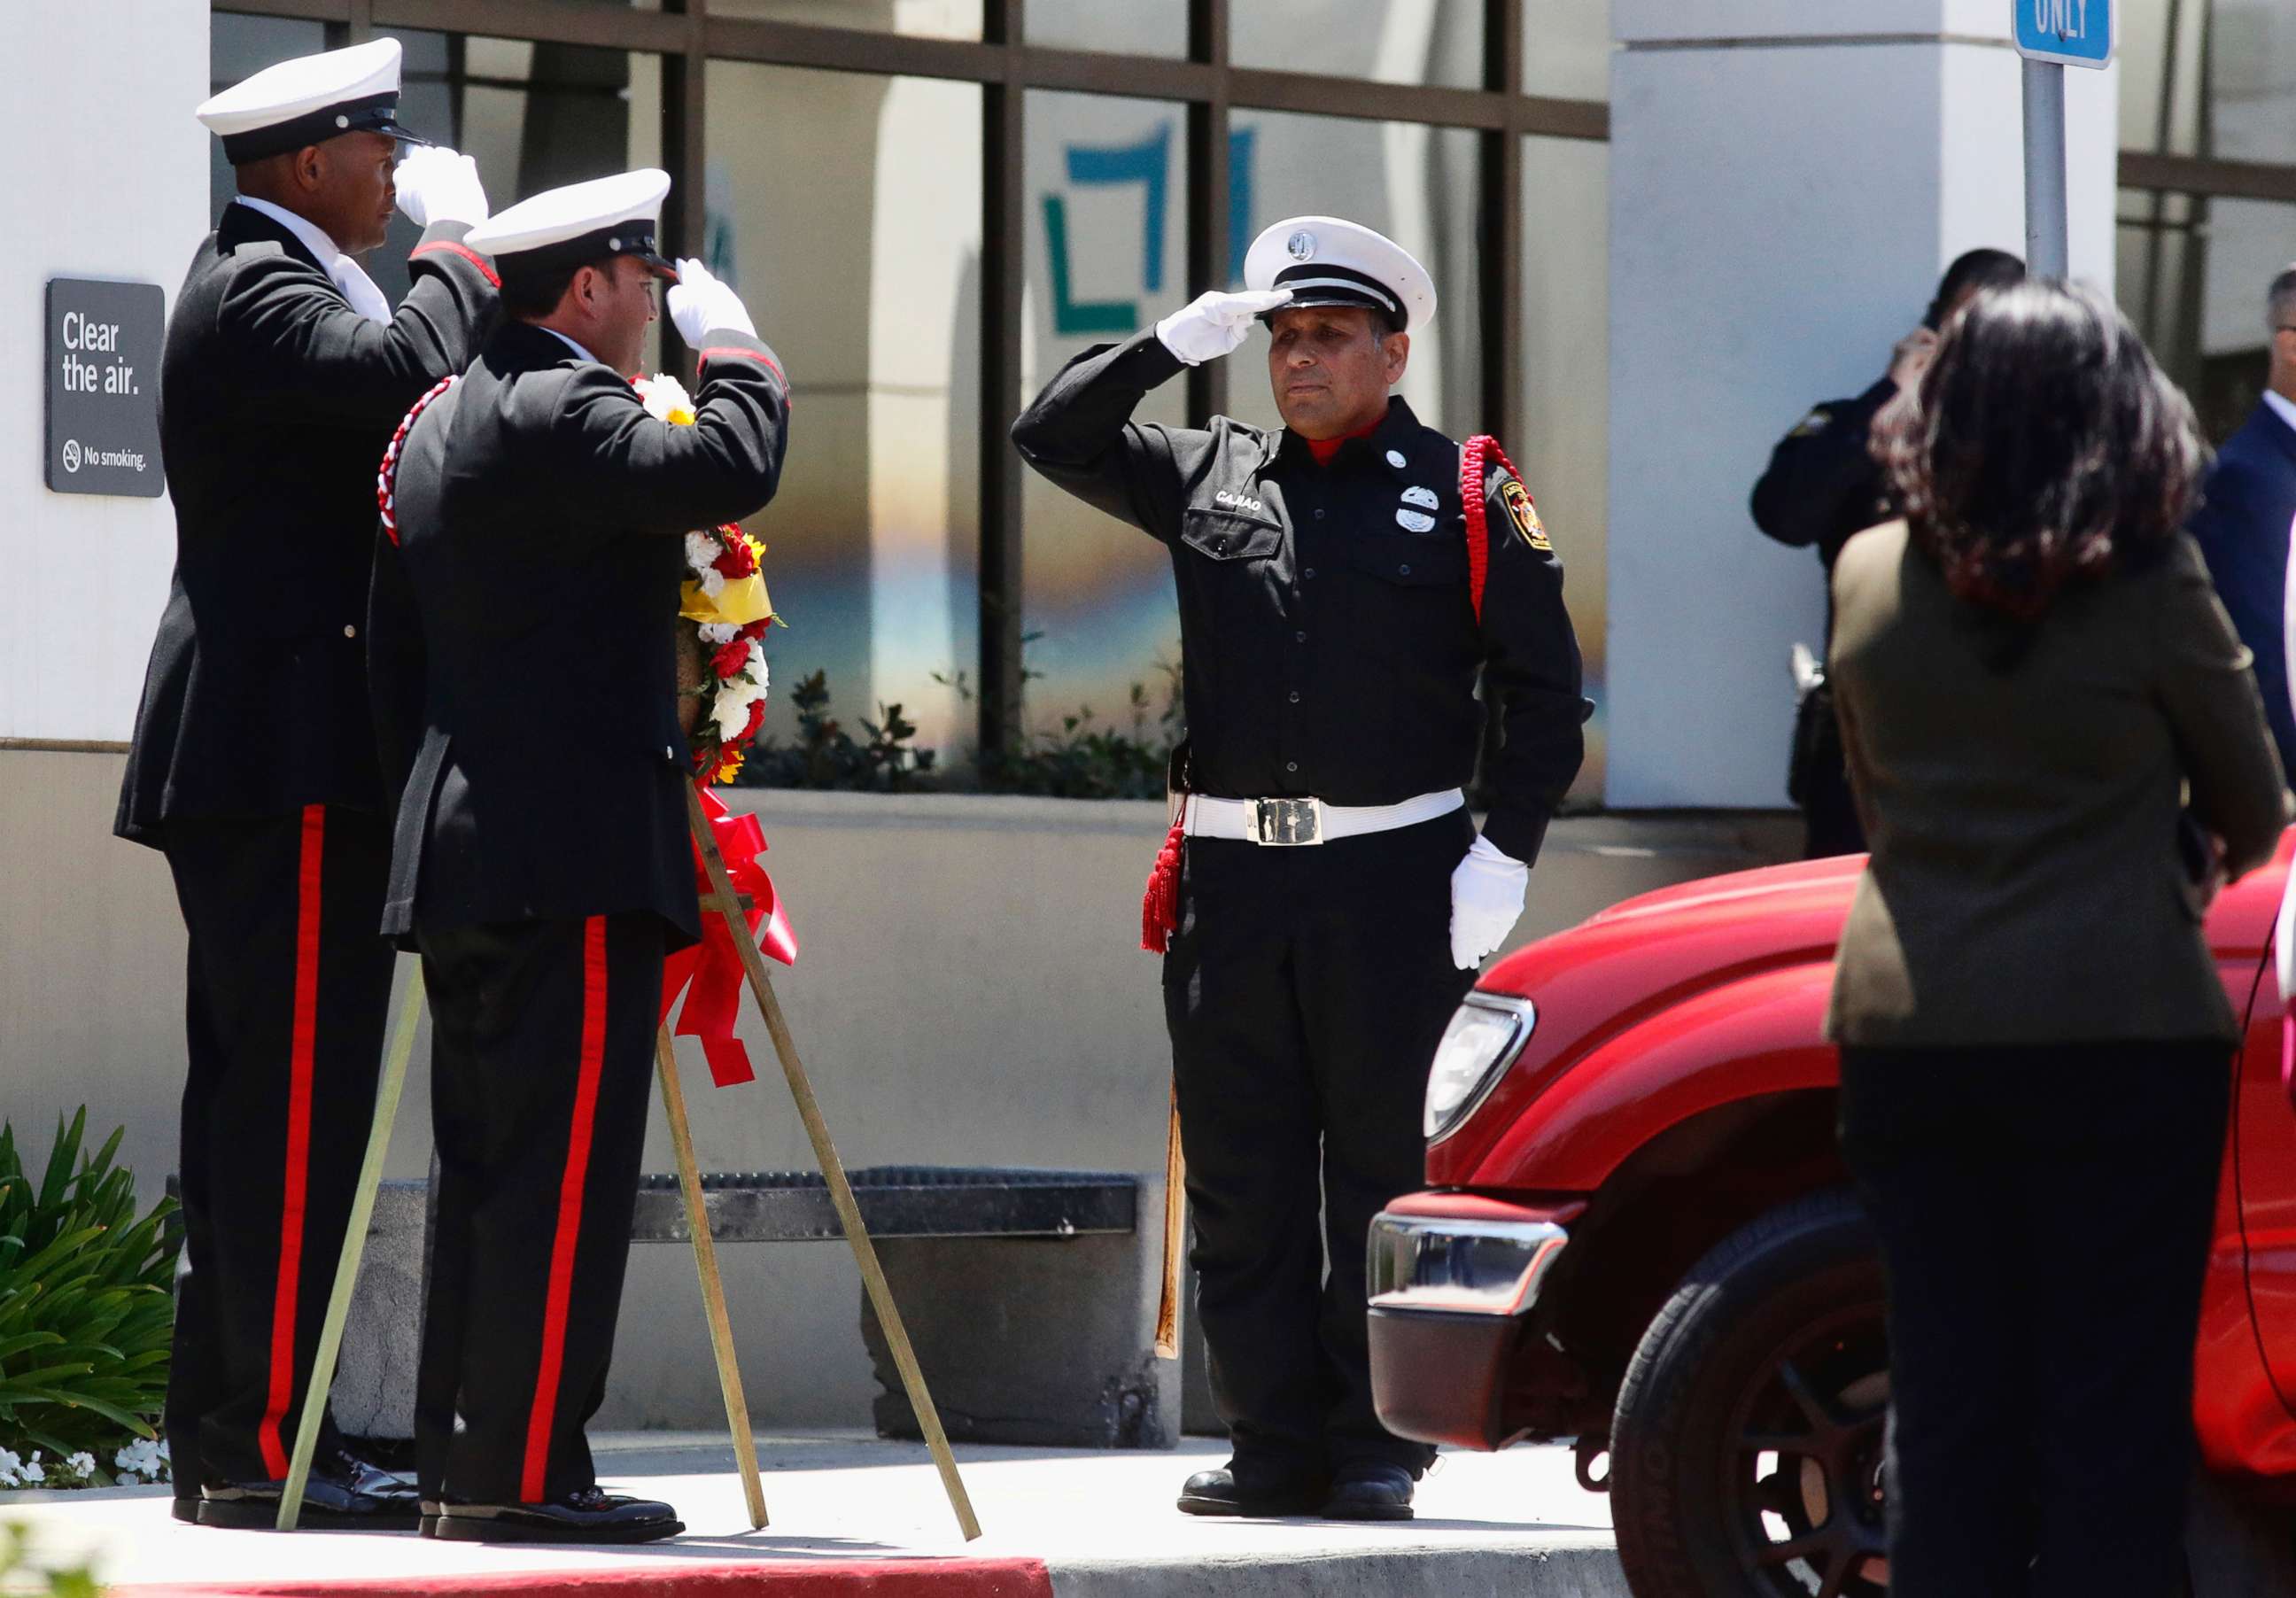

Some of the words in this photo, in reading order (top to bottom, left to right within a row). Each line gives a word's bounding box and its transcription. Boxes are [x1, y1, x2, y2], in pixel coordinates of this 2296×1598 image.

[2035, 0, 2086, 38] ONLY
[63, 312, 119, 352] Clear
[62, 354, 97, 392] the
[105, 356, 138, 394] air.
[85, 446, 98, 465] No
[102, 449, 146, 471] smoking.
